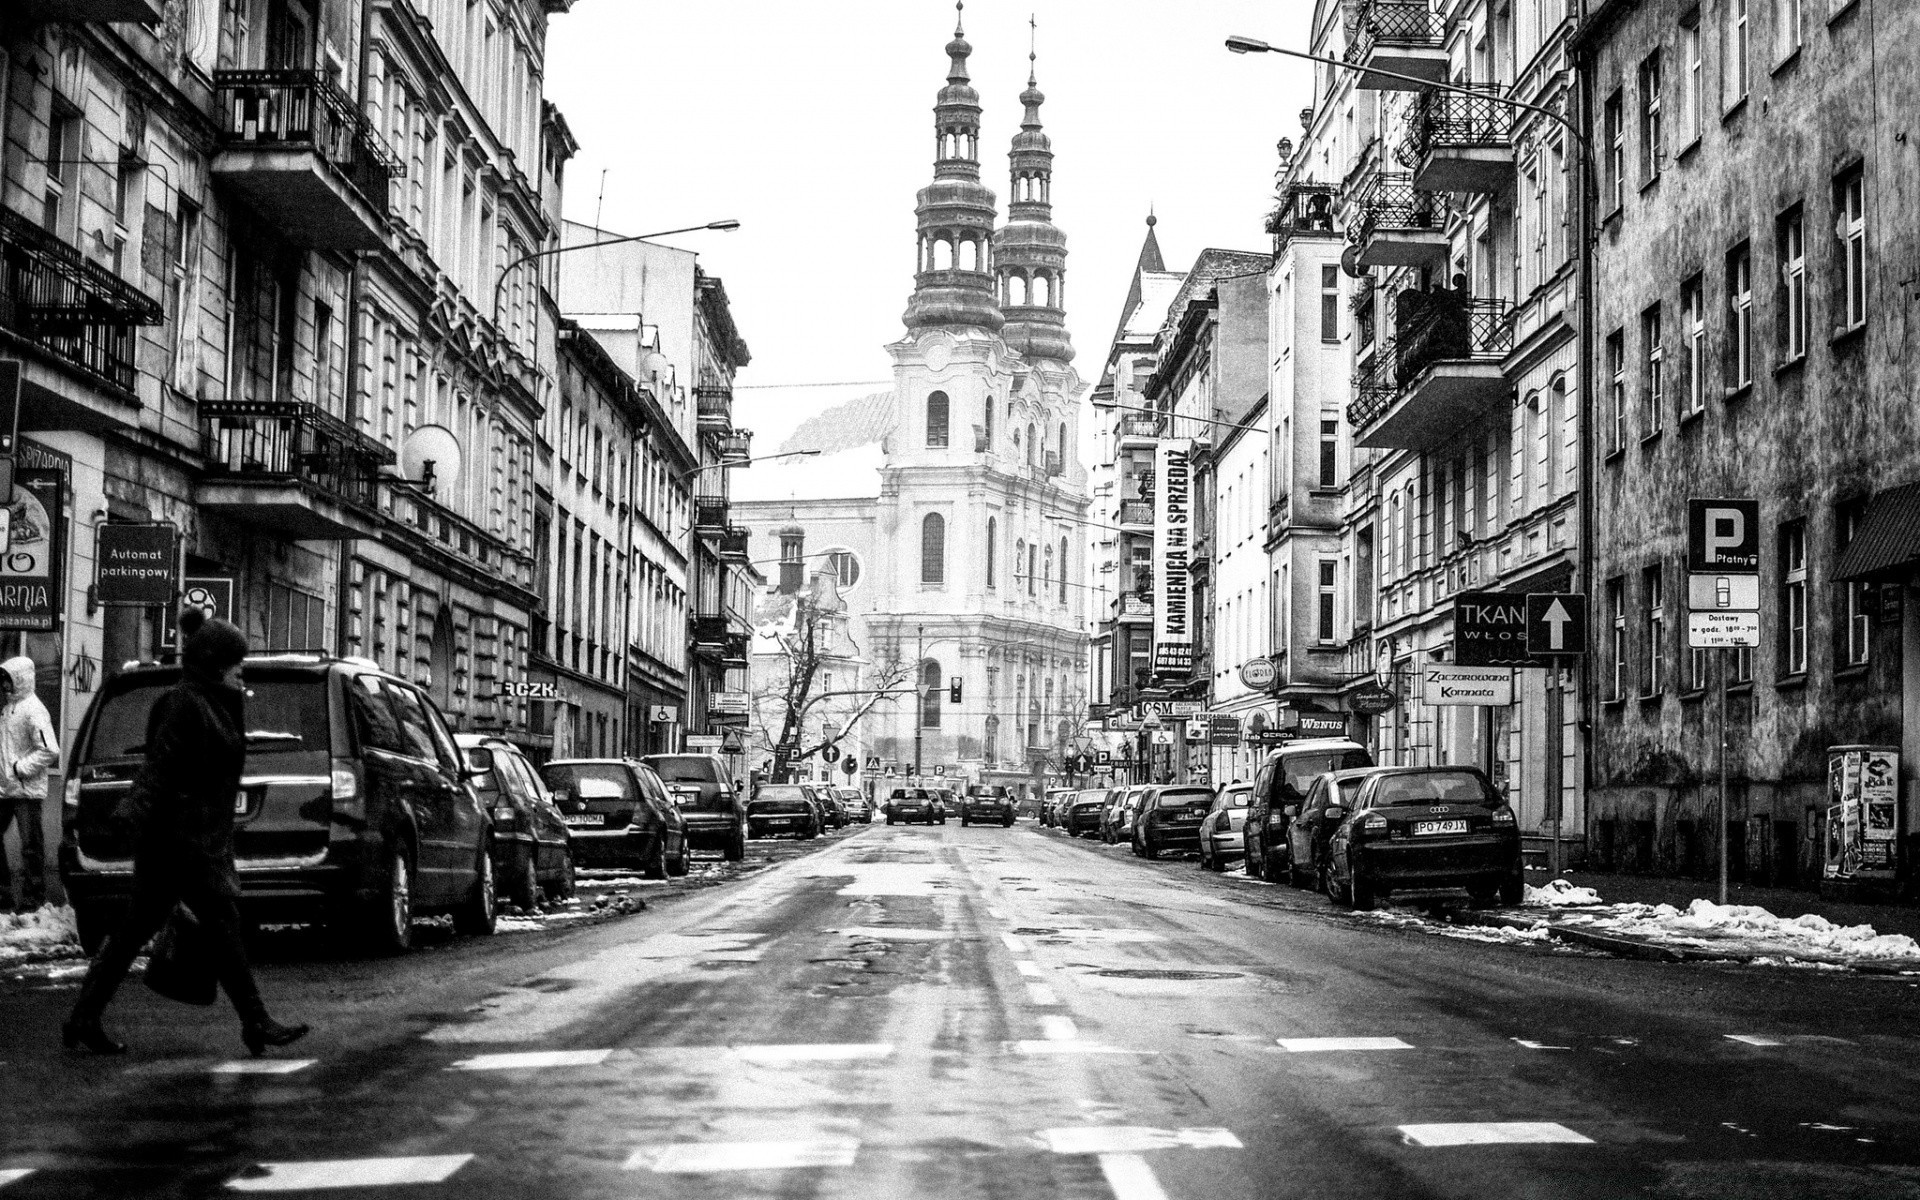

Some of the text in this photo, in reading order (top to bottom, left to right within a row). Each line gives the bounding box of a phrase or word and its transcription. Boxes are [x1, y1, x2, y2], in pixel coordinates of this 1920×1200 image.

[1164, 450, 1188, 634] KAMIENICA NA SPRZEDAŻ
[110, 549, 161, 559] Automat
[1717, 554, 1748, 566] Płatny
[101, 566, 168, 579] parkingowy
[0, 585, 48, 612] RNIA
[1461, 604, 1524, 624] TKAN
[1441, 687, 1494, 697] Komnata
